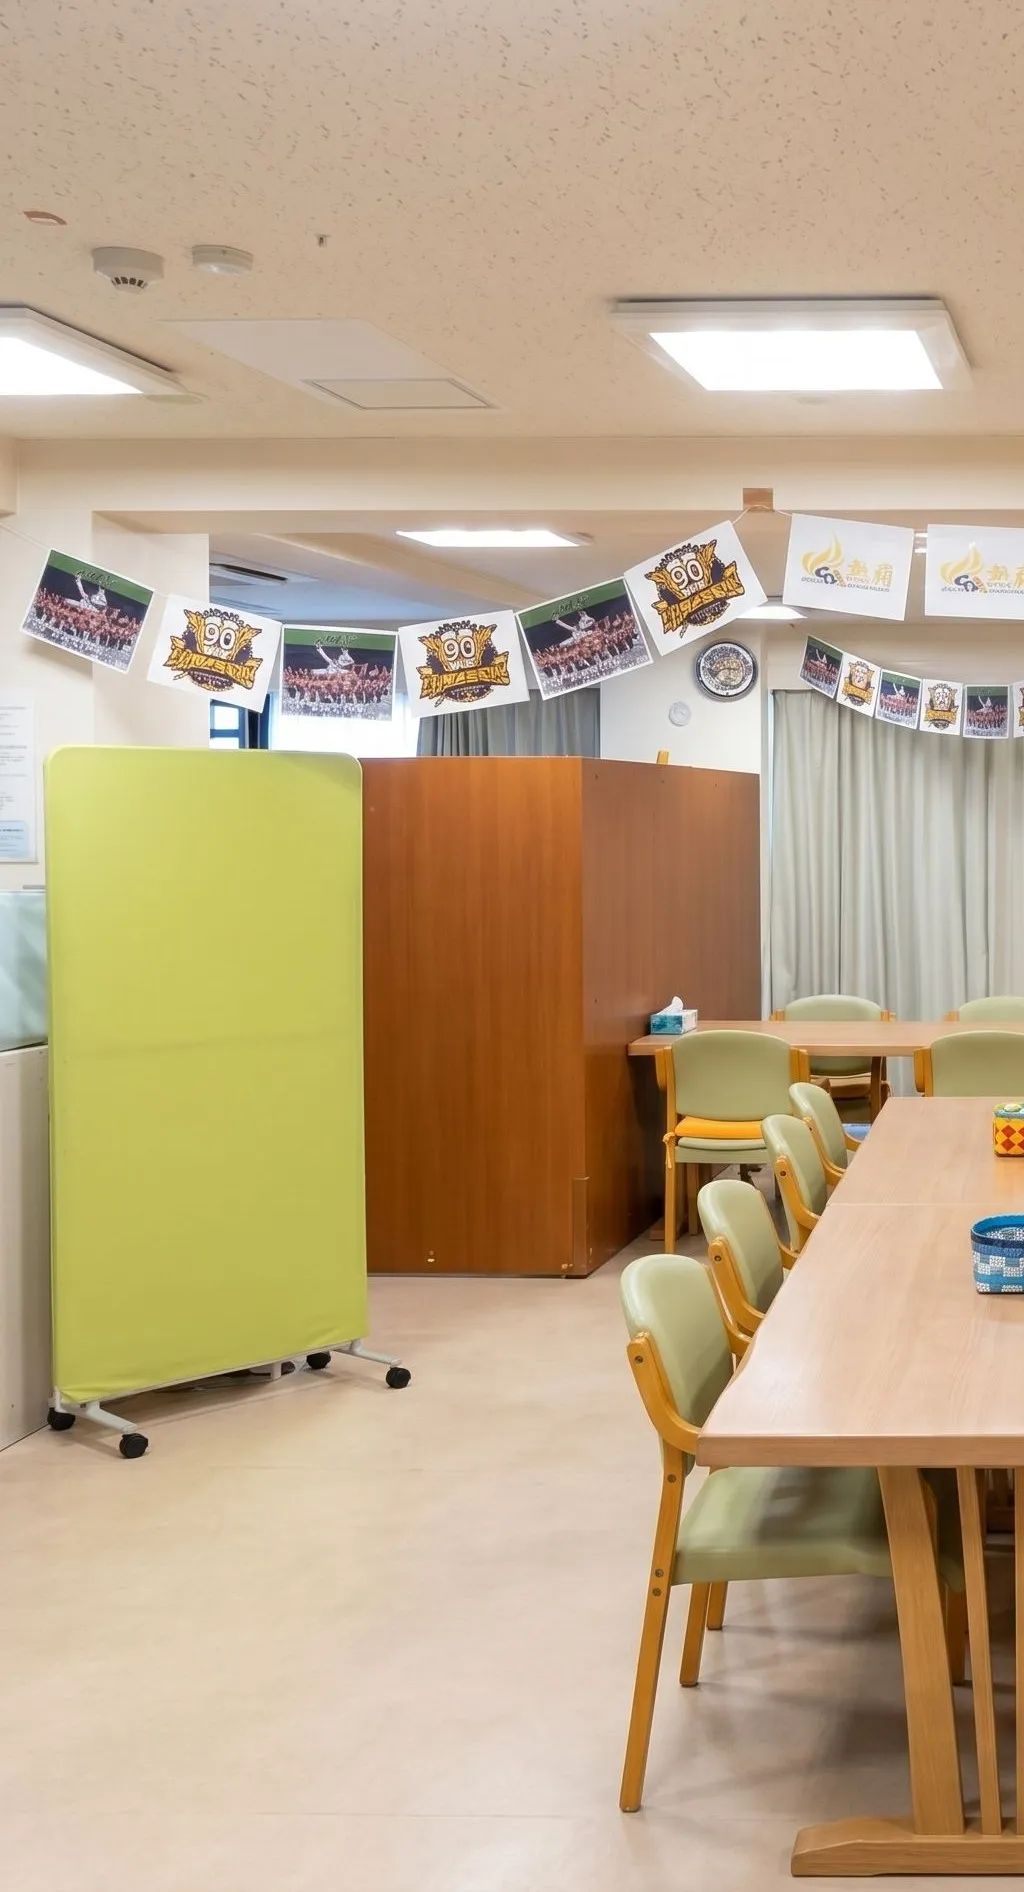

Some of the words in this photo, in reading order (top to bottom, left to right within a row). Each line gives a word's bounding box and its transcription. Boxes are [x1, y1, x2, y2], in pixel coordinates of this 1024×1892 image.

[670, 558, 704, 591] 90
[203, 622, 236, 650] 90
[442, 636, 476, 662] 90
